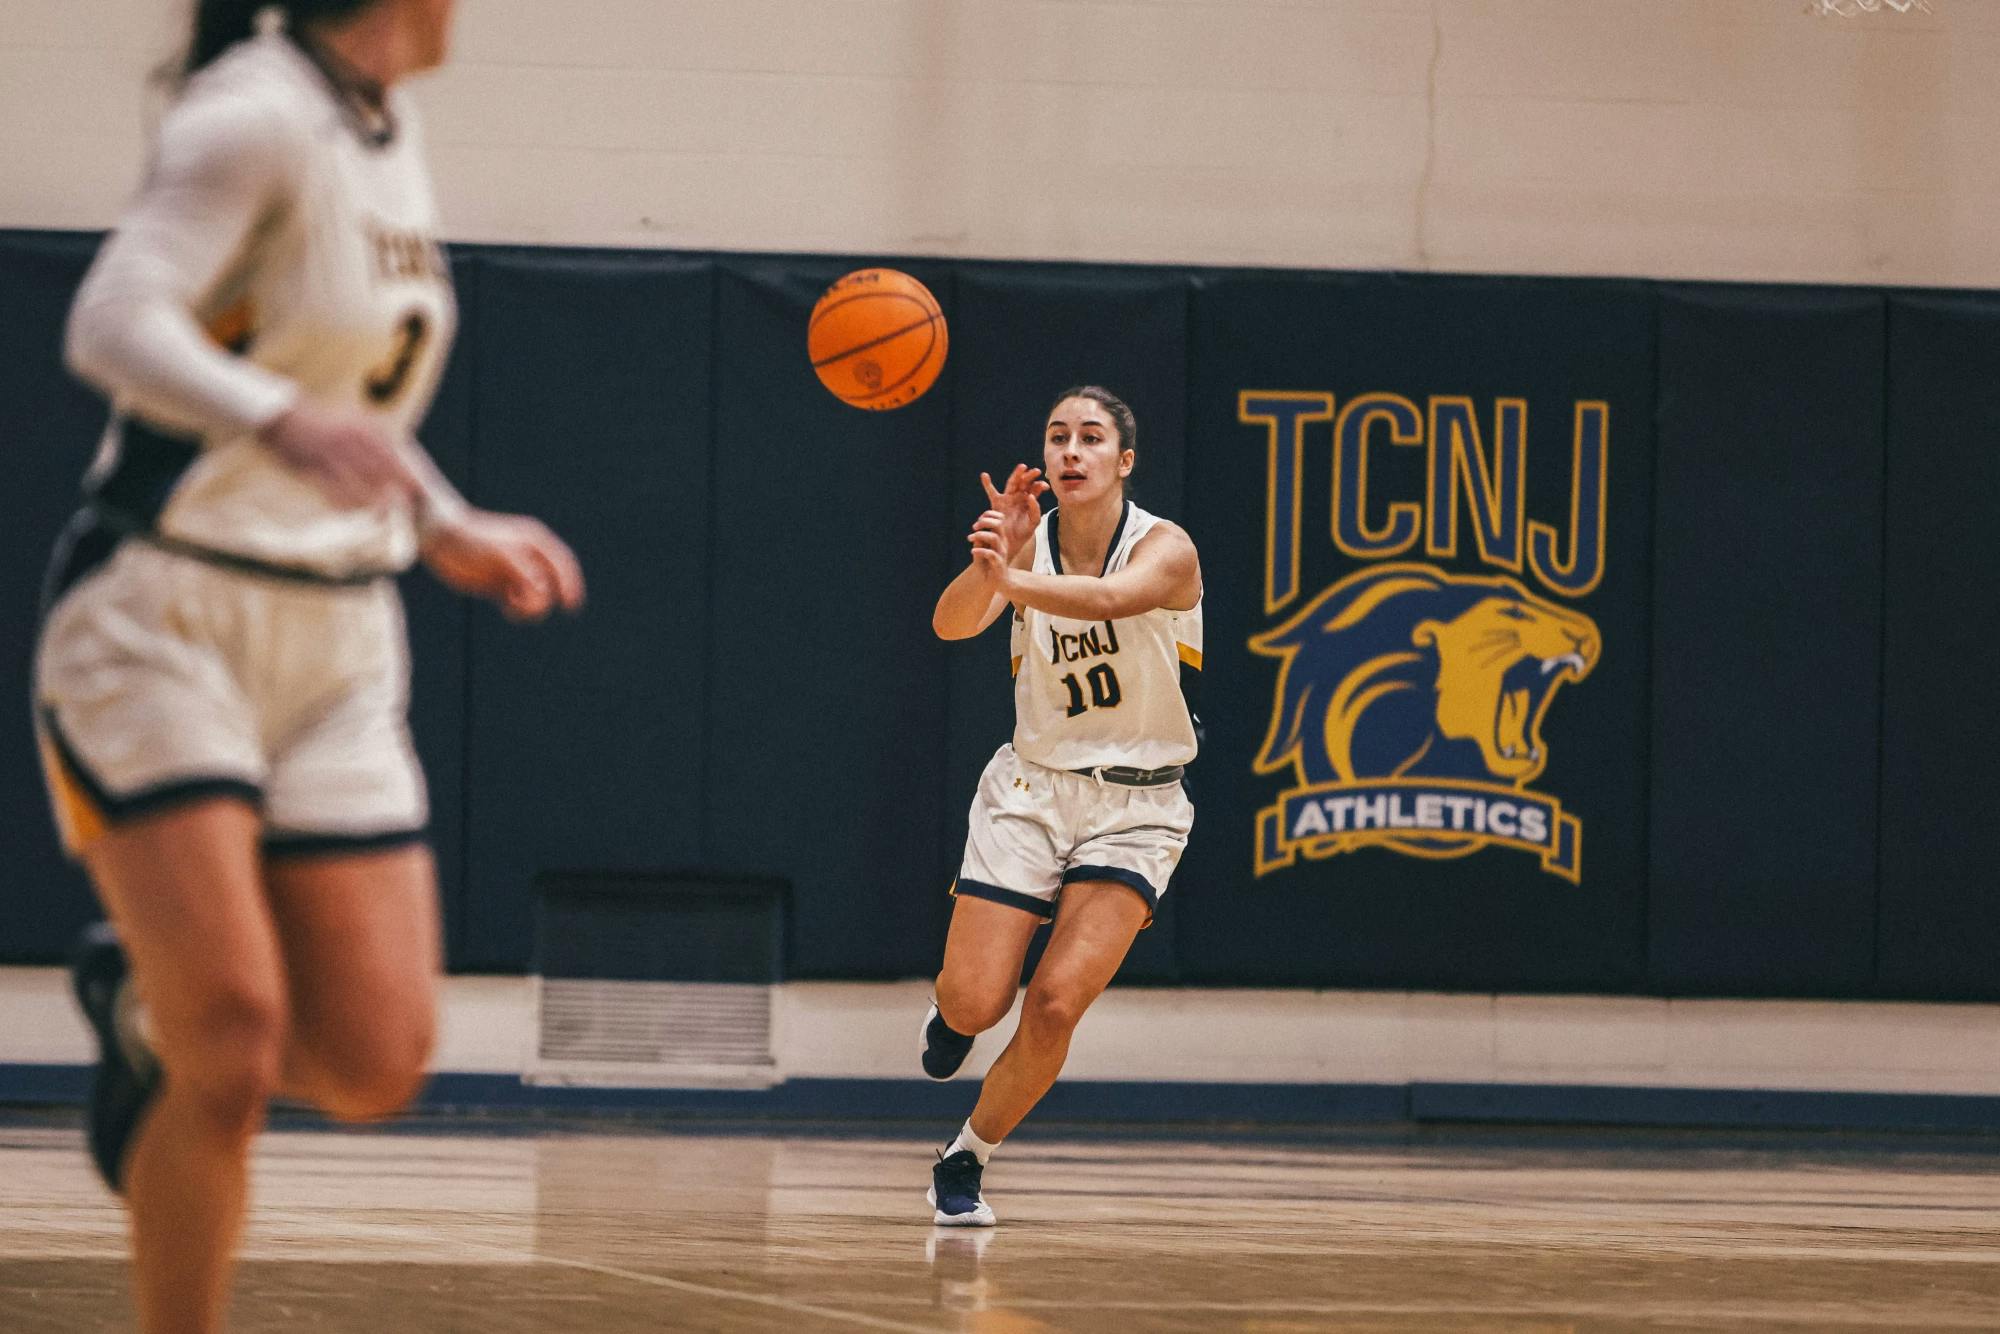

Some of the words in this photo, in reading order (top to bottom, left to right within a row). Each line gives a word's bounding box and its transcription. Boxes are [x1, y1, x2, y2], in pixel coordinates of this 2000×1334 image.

[1238, 389, 1609, 613] TCNJ
[1060, 662, 1122, 718] 10
[1293, 793, 1547, 842] ATHLETICS
